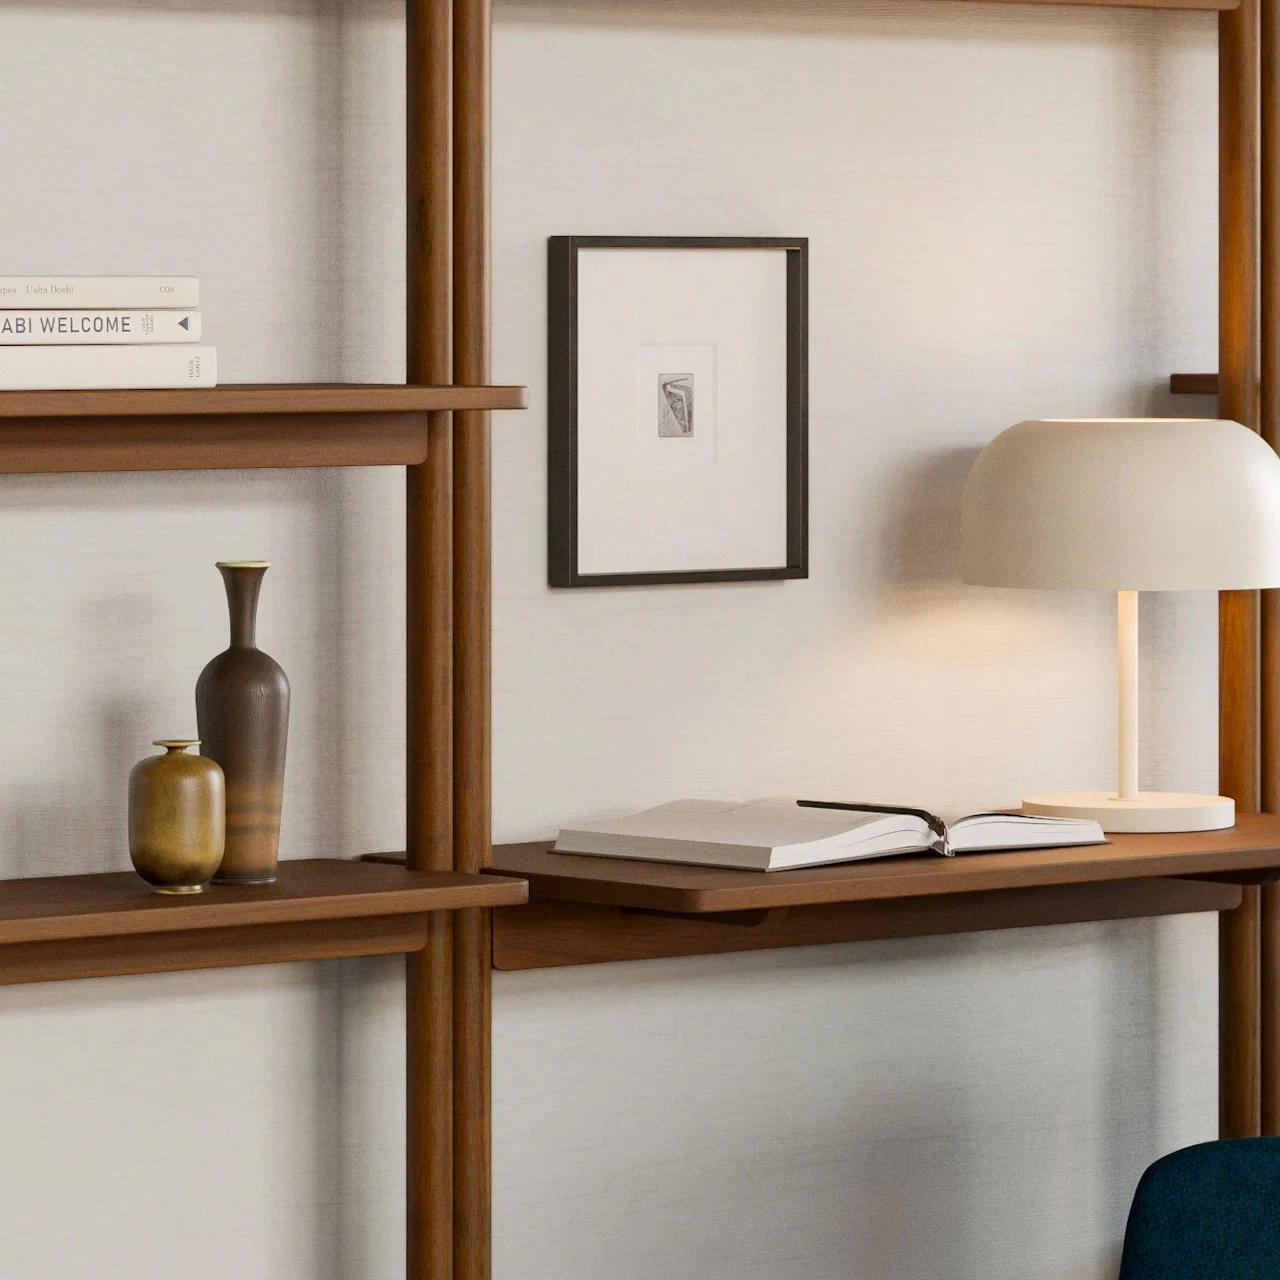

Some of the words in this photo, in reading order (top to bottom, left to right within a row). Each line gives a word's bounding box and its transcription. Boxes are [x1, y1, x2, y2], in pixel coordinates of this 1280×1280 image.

[26, 285, 48, 294] Usha
[50, 284, 75, 294] Doshi
[40, 317, 131, 333] WELCOME
